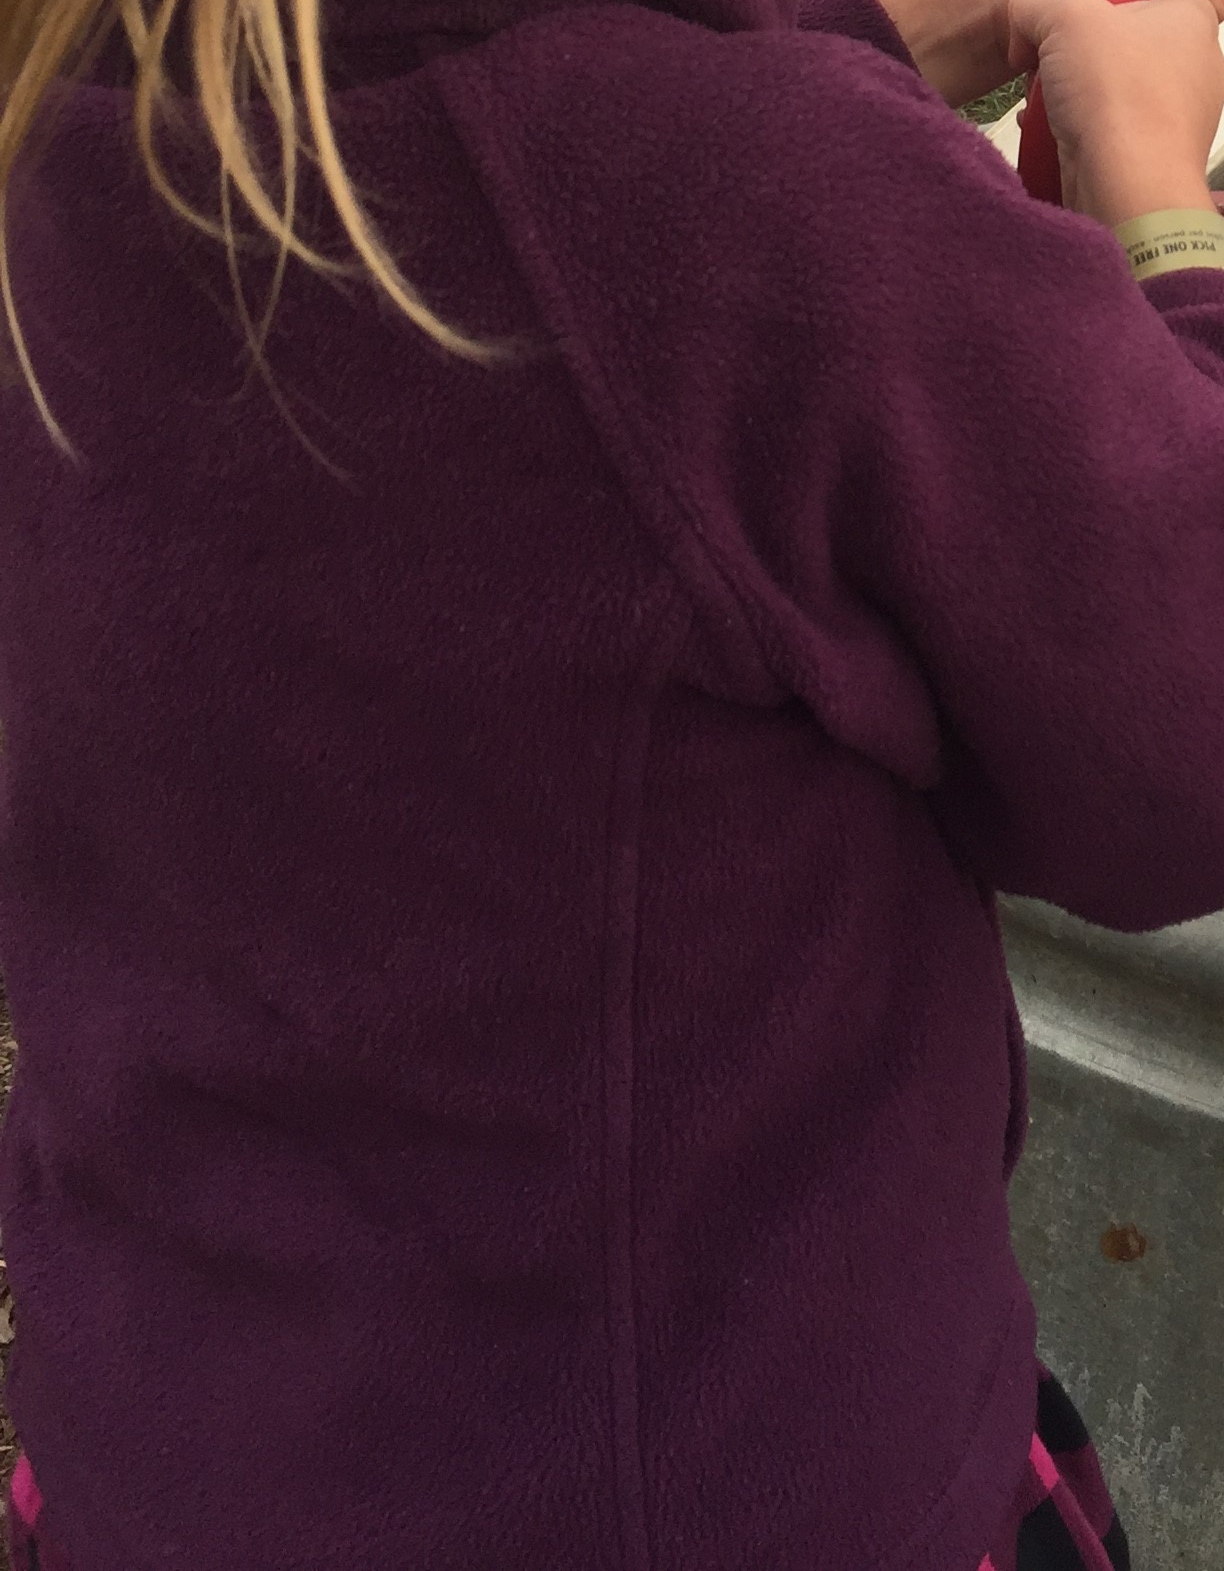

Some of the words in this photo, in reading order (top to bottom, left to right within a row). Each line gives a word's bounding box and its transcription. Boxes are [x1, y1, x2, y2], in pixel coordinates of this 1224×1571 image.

[1164, 240, 1188, 254] ONE
[1190, 240, 1217, 252] PICK
[1134, 245, 1160, 266] FREE
